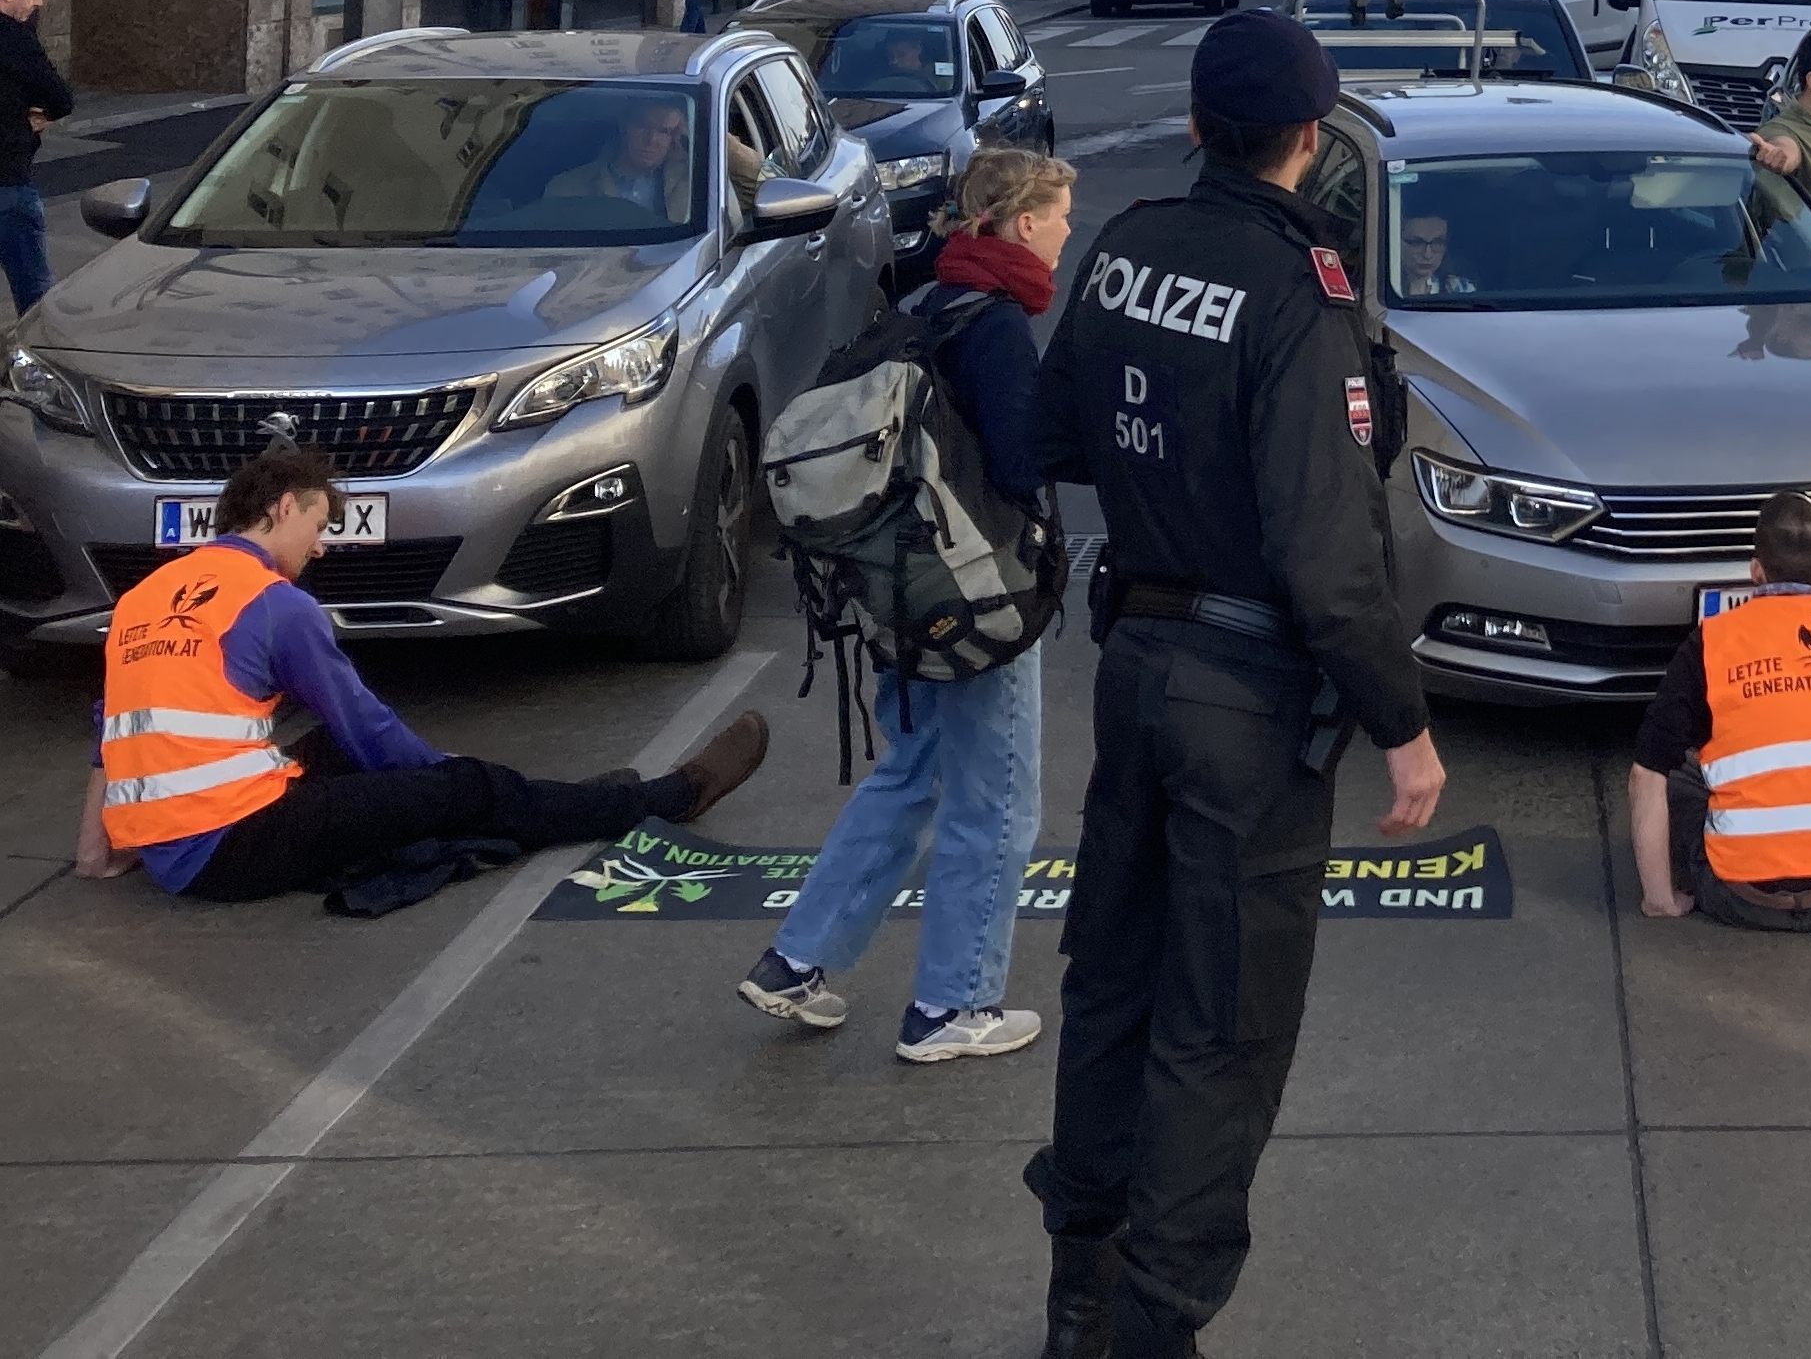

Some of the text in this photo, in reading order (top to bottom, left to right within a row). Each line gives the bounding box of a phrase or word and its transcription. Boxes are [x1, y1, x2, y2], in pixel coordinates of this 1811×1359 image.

[1081, 251, 1247, 344] POLIZEI
[1124, 364, 1148, 405] D
[1115, 411, 1165, 460] 501
[1727, 656, 1784, 684] LETZTE
[1324, 843, 1486, 879] KEINE
[1375, 885, 1485, 910] UND
